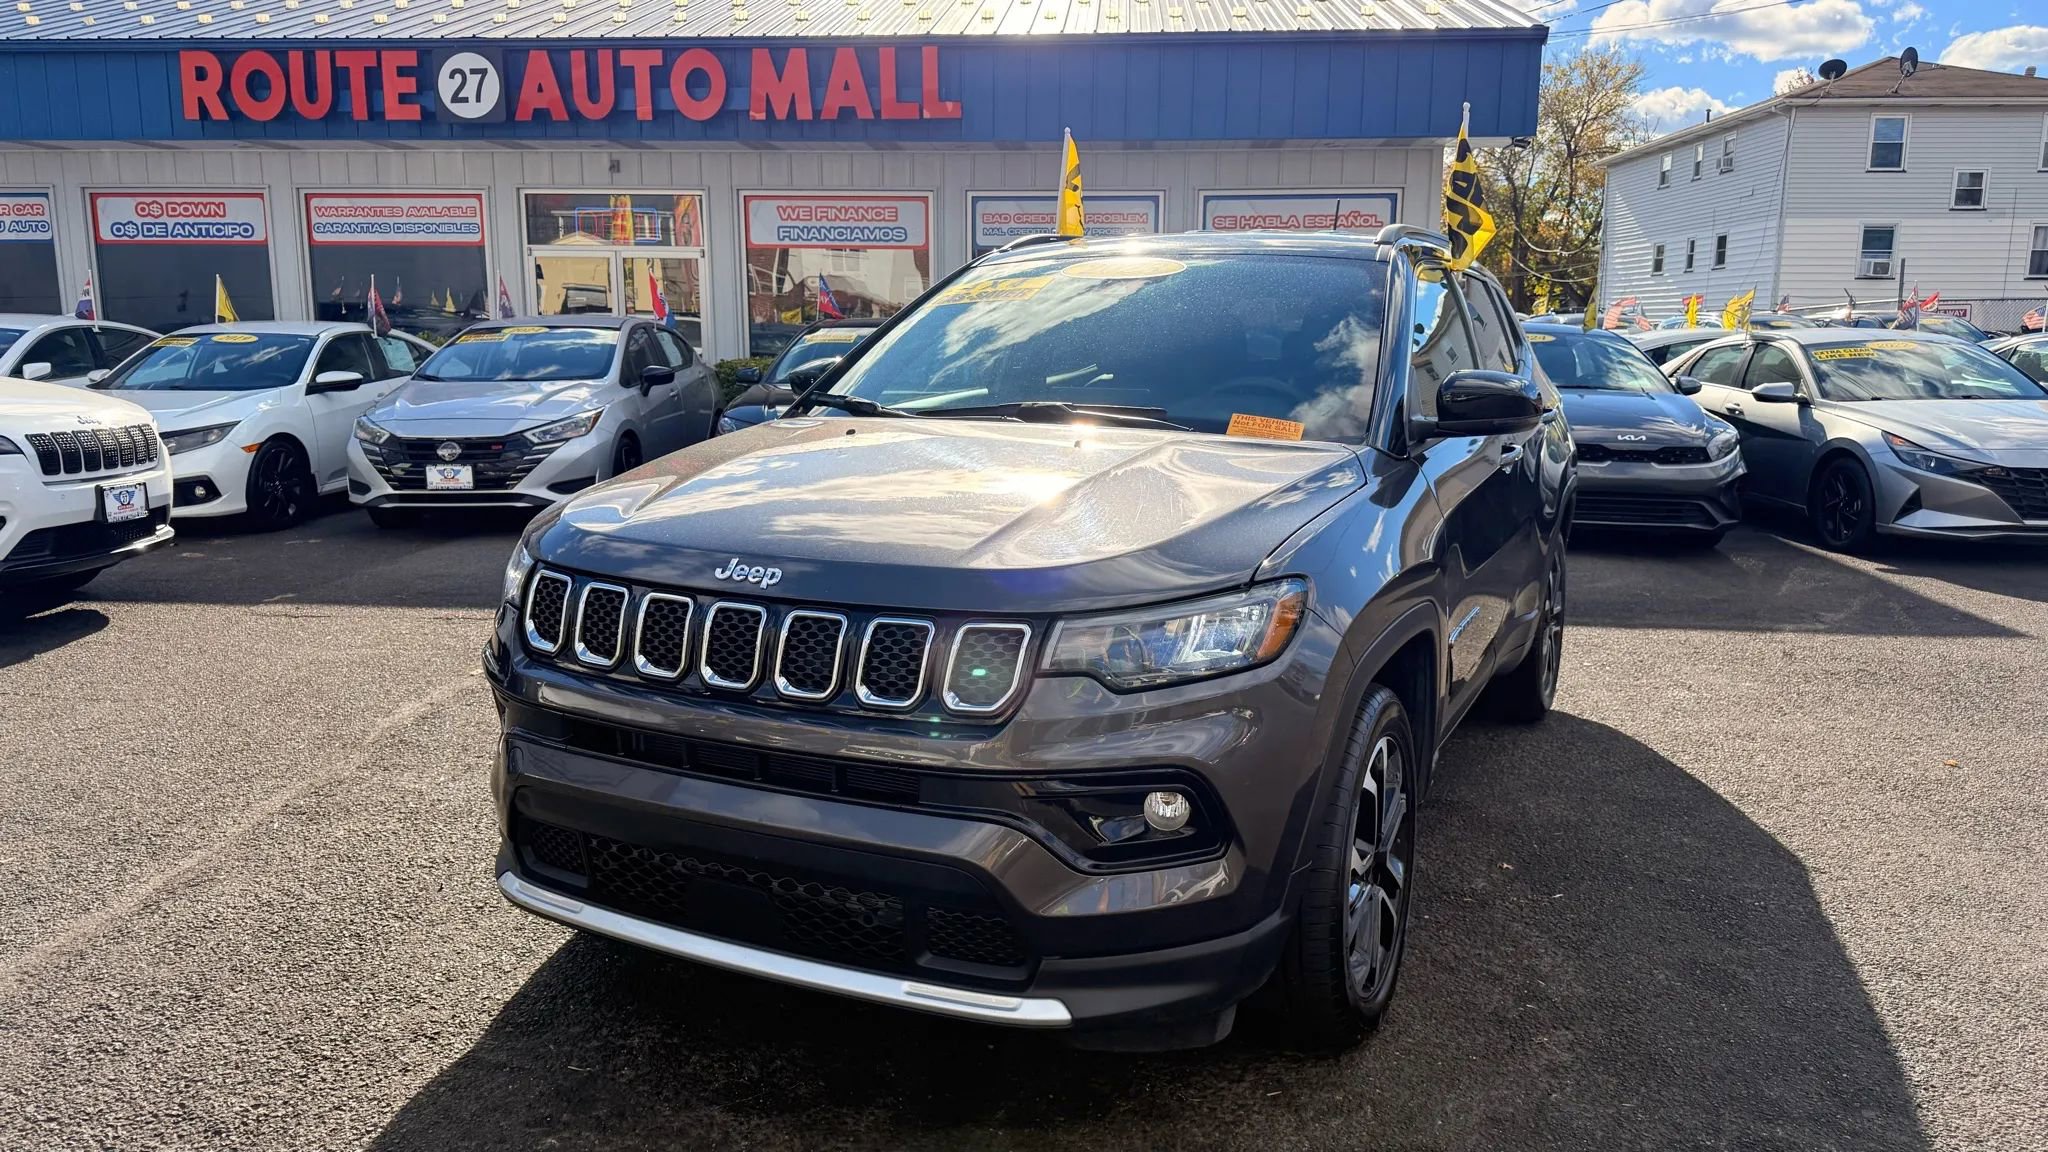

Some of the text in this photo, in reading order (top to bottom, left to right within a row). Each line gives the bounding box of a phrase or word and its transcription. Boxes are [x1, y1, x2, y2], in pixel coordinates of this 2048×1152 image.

[179, 45, 962, 122] ROUTE 27 AUTO MALL
[13, 203, 45, 216] CAR
[167, 203, 226, 217] DOWN
[315, 206, 476, 217] WARRANTIES AVAILABLE
[777, 206, 898, 222] WE FINANCE
[983, 213, 1011, 224] BAD
[1087, 213, 1148, 224] PROBLEM
[1213, 211, 1384, 229] SE HABLA ESPAÑOL
[10, 220, 50, 233] AUTO
[142, 222, 168, 238] DE
[171, 222, 254, 238] ANTICIPO
[313, 222, 480, 234] GARANTIAS DISPONIBLES
[983, 228, 1006, 236] MAL
[1007, 228, 1049, 236] CREDITO
[778, 226, 907, 242] FINANCIAMOS
[714, 557, 783, 590] Jeep
